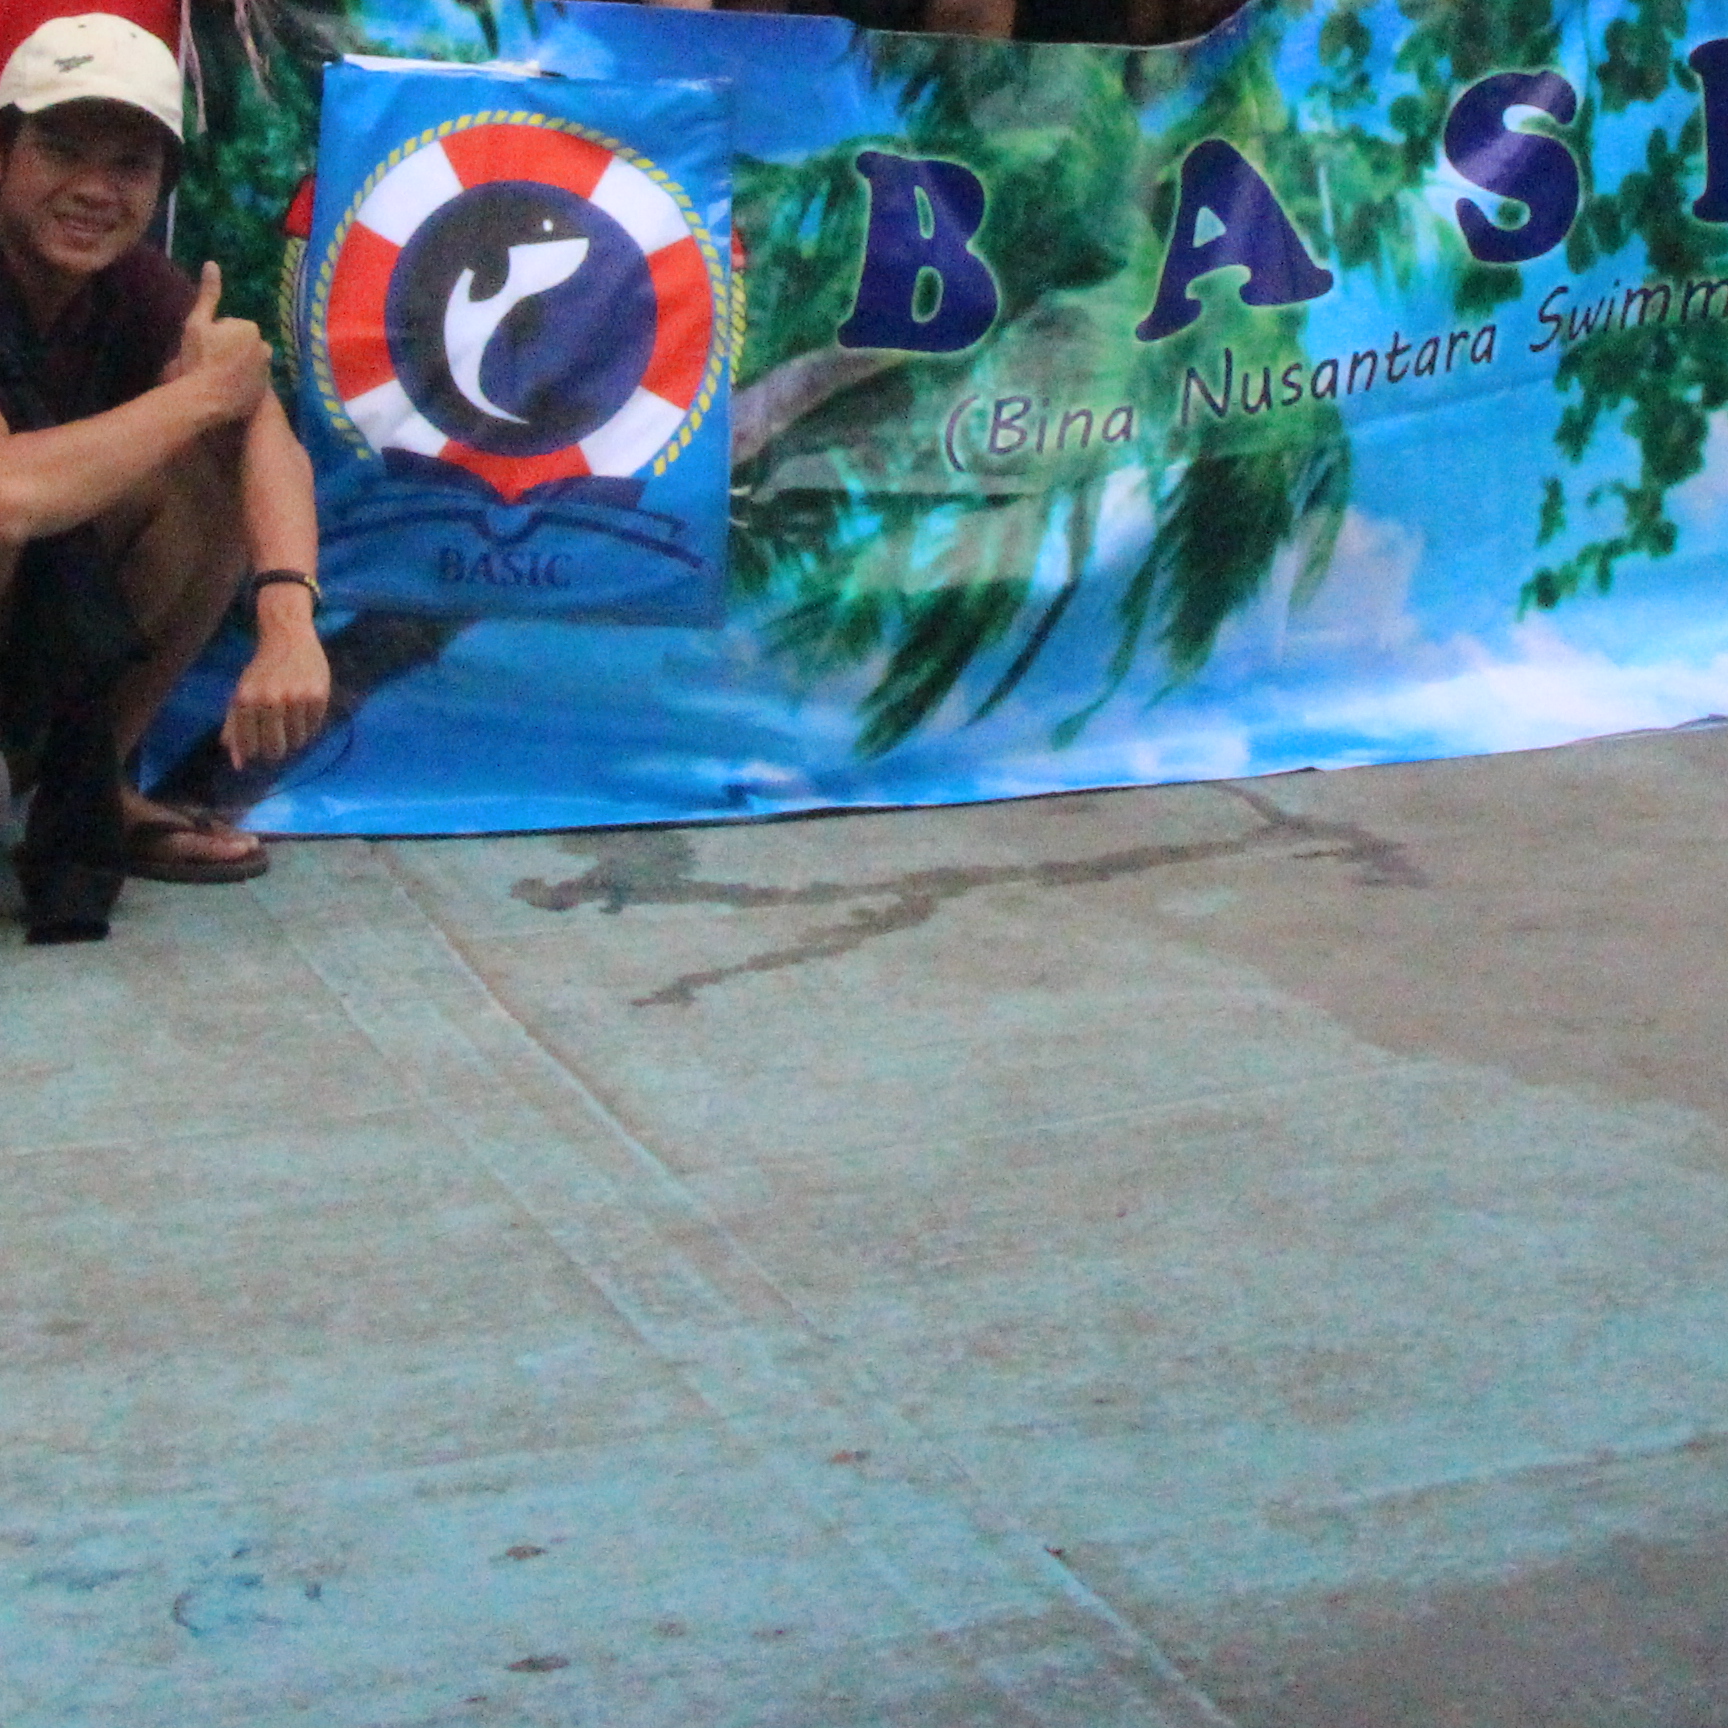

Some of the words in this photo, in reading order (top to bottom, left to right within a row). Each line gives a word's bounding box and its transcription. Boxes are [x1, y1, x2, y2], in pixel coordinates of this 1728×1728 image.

[943, 394, 1134, 472] (Bina
[1178, 323, 1497, 428] Nusantara
[438, 546, 573, 588] BASIC
